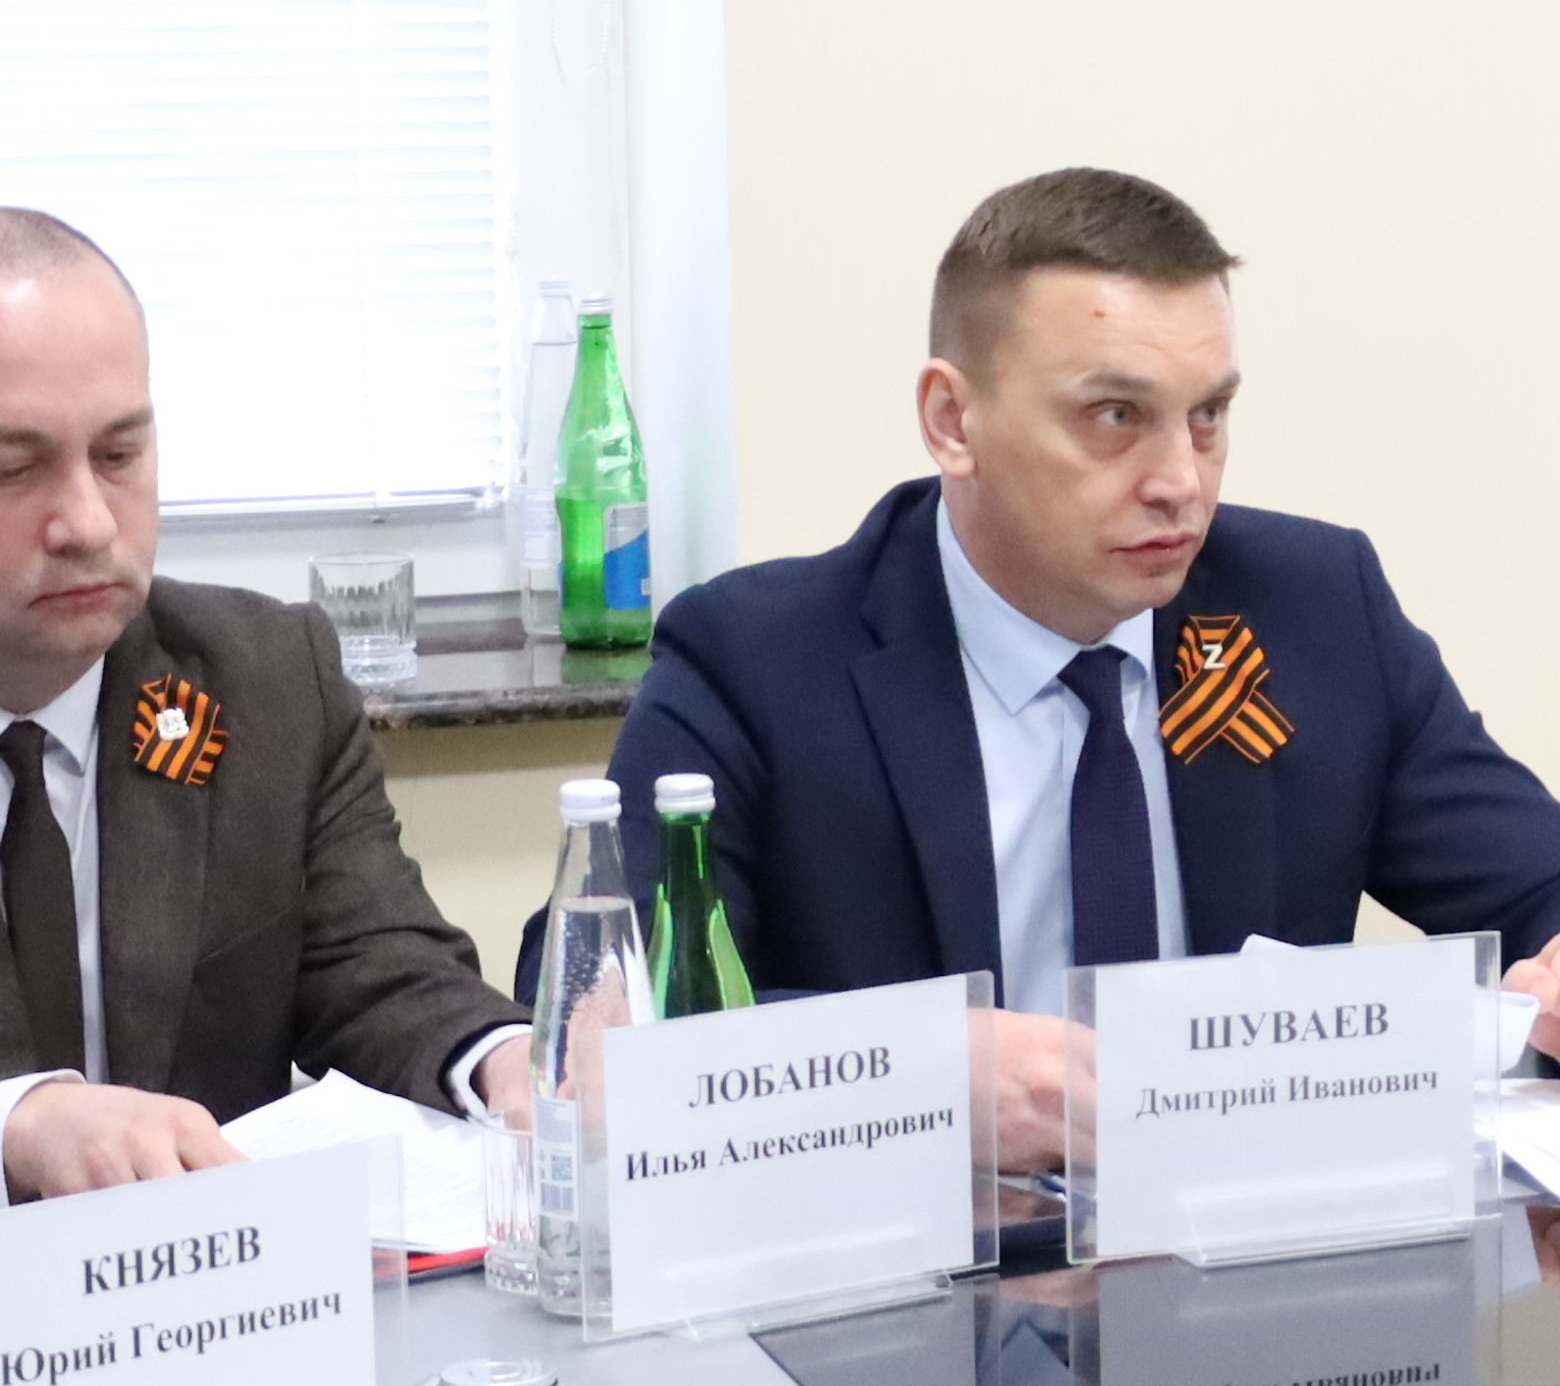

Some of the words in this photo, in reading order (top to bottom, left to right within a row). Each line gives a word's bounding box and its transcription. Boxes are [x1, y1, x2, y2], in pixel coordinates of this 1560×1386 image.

[1188, 1003, 1389, 1051] ШУВАЕВ
[688, 1047, 891, 1108] ЛОБАНОВ
[1135, 1077, 1276, 1119] Дмитрий
[1288, 1071, 1437, 1102] Иванович
[627, 1150, 706, 1181] Илья
[718, 1108, 953, 1164] Александрович
[83, 1227, 261, 1295] КНЯЗЕВ
[0, 1331, 116, 1386] Юрий
[132, 1293, 341, 1359] Георгиевич
